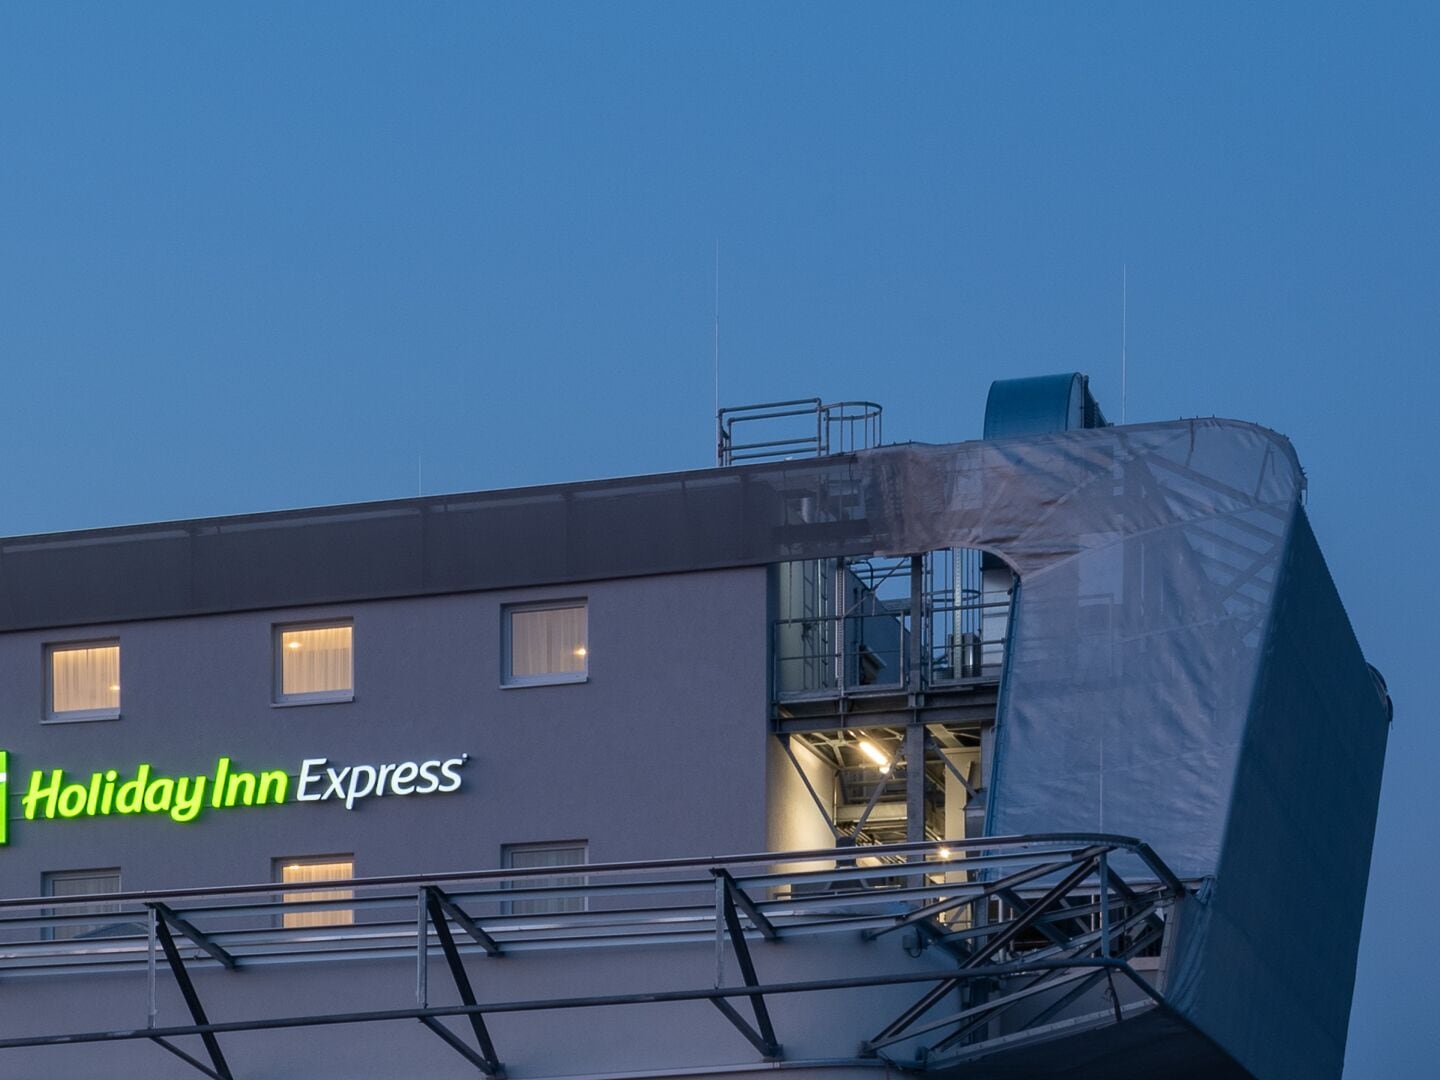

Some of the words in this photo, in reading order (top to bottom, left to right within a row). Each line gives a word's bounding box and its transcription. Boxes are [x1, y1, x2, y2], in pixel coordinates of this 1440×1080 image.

[23, 763, 205, 823] Holiday
[212, 757, 288, 809] Inn
[296, 753, 463, 810] Express
